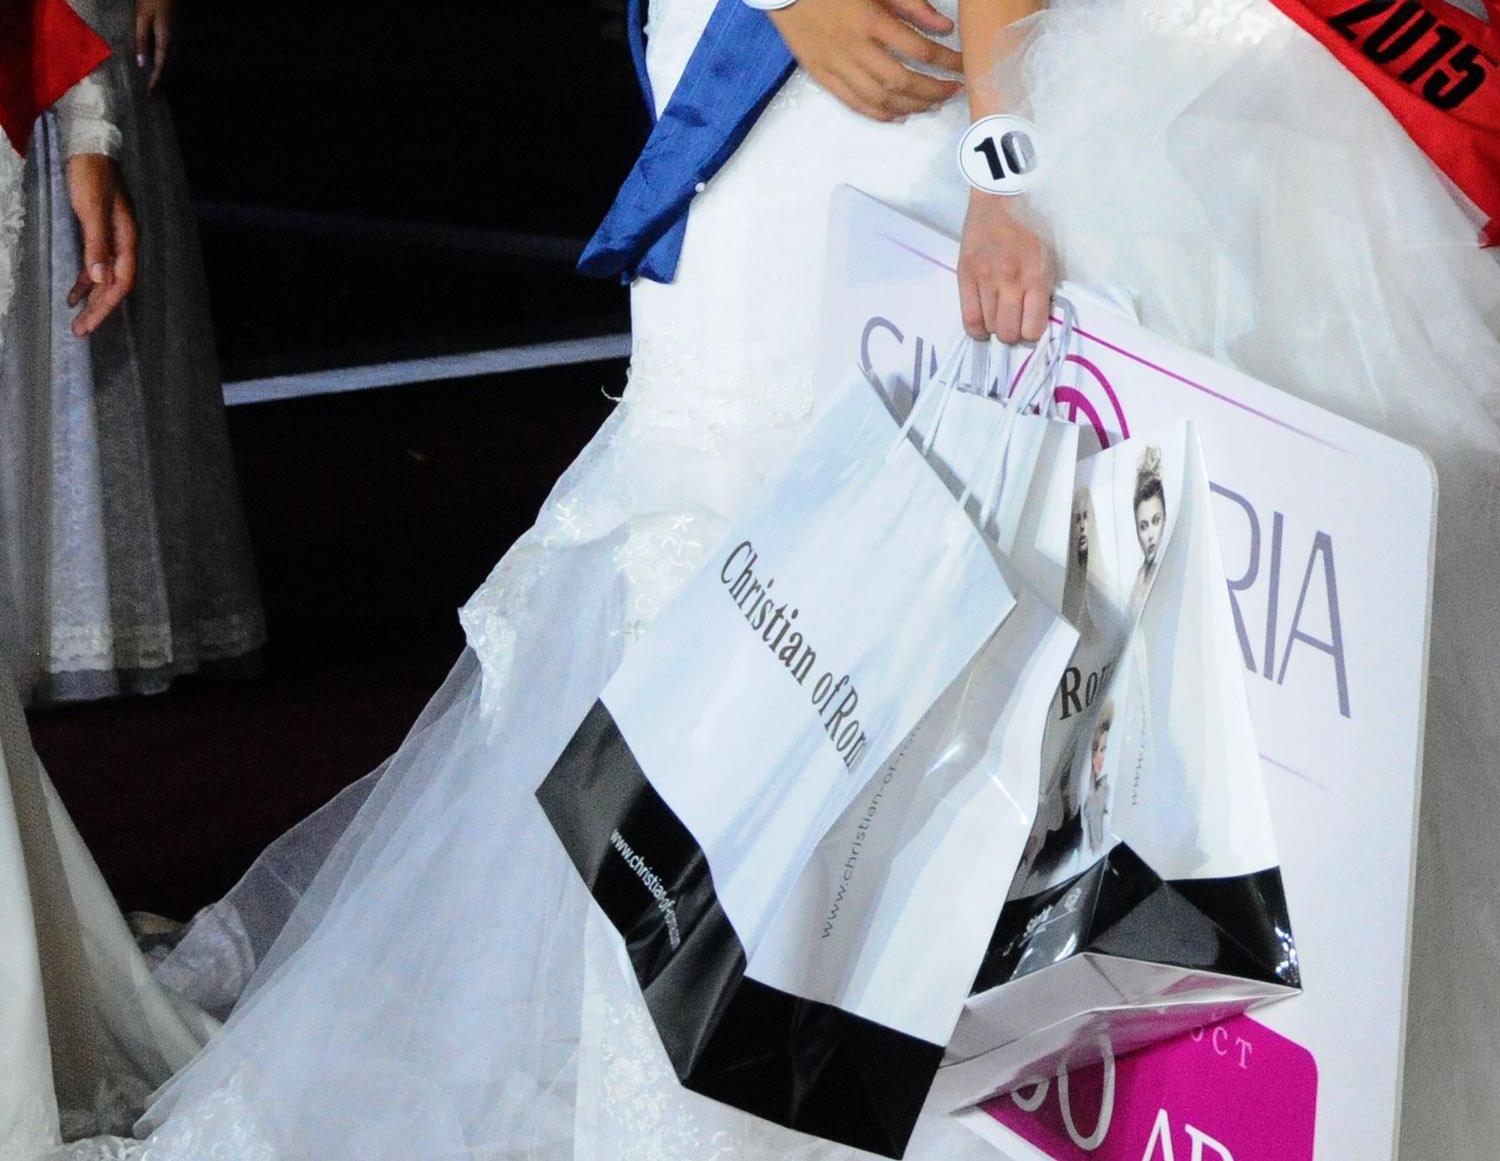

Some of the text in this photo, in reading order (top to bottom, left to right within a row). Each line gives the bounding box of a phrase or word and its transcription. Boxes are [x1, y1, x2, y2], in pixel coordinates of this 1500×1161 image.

[973, 130, 1037, 181] 10
[720, 540, 818, 685] Christian
[810, 671, 851, 716] of
